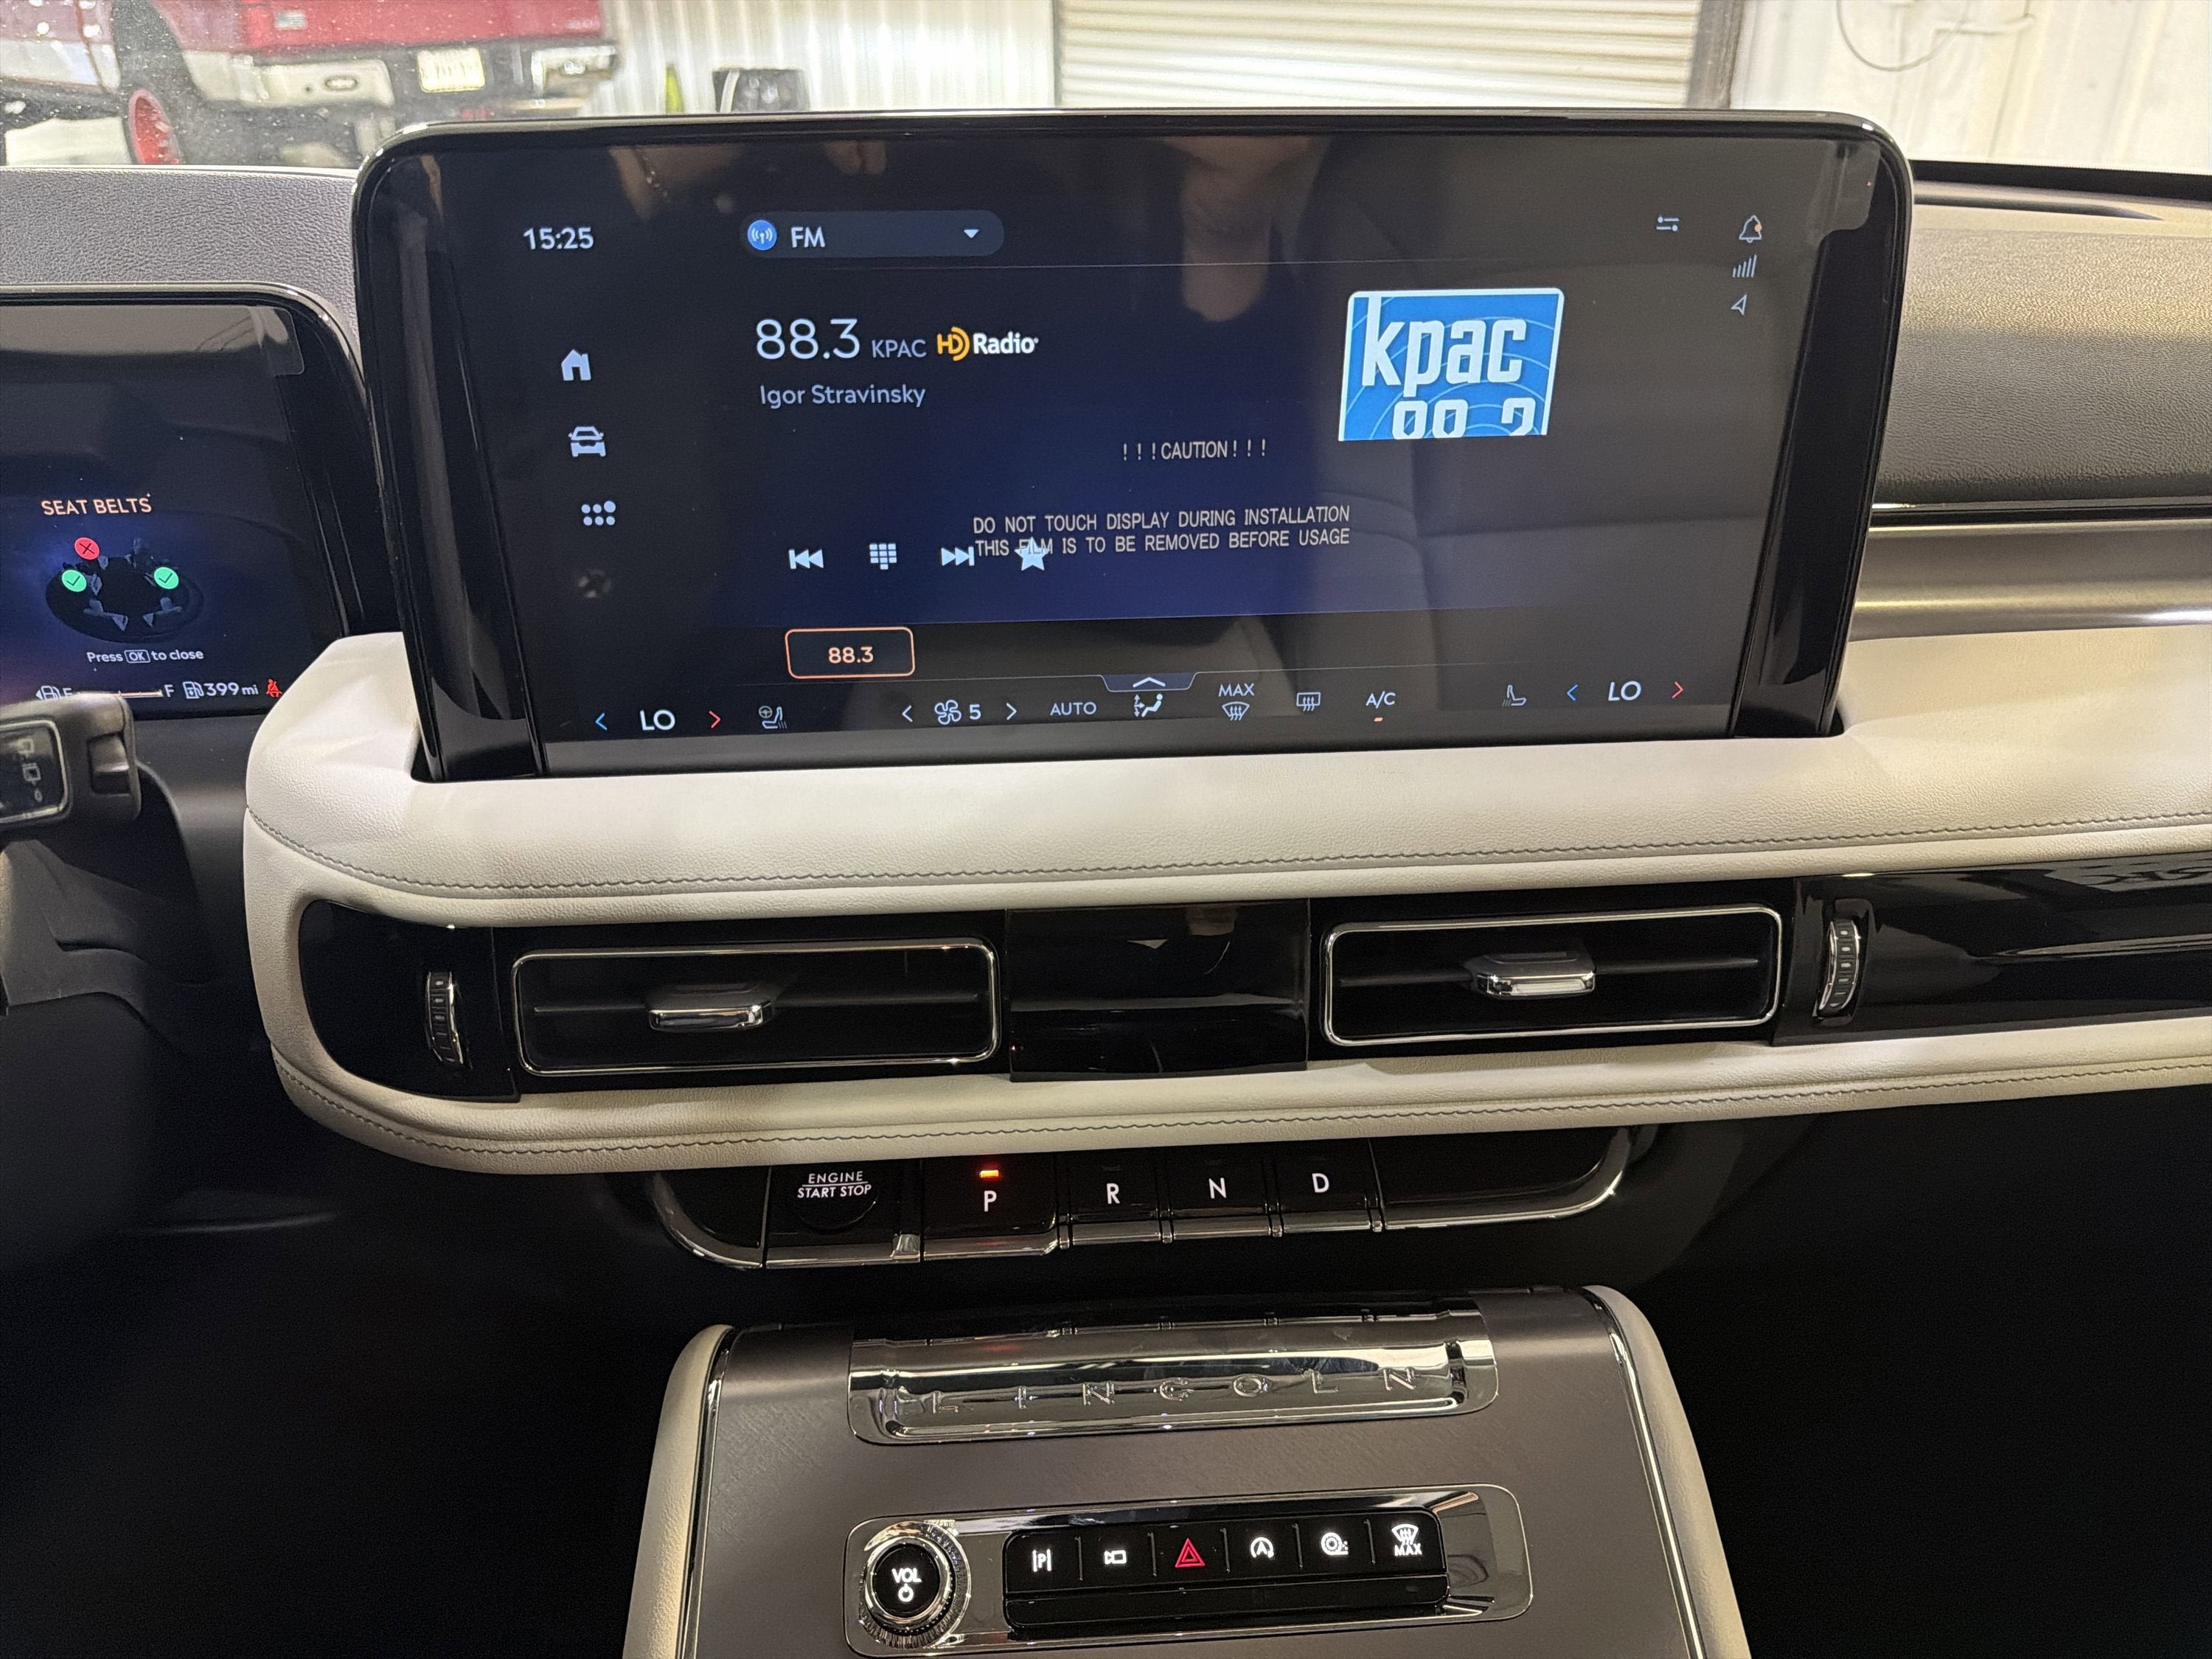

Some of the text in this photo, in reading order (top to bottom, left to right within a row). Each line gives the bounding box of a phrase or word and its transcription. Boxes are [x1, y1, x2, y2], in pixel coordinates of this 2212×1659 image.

[524, 226, 594, 250] 15:25
[790, 226, 826, 248] FM
[756, 318, 860, 360] 88.3
[872, 338, 927, 358] KPAC
[1362, 296, 1527, 397] kpac
[760, 383, 926, 409] Igor Stravinsky
[41, 498, 152, 515] SEAT BELTS
[973, 505, 1350, 534] DO NOT TOUCH DISPLAY DURING INSTALLATION
[975, 539, 1009, 557] THIS
[1062, 537, 1077, 554] IS
[1085, 536, 1106, 554] TO
[1115, 535, 1136, 552] BE
[1145, 532, 1220, 552] REMOVED
[1228, 529, 1290, 549] BEFORE
[1299, 527, 1350, 546] USAGE
[86, 649, 204, 663] Press OK to close
[828, 646, 874, 664] 88.3
[164, 684, 175, 698] F
[203, 682, 259, 697] 399 mi
[1218, 683, 1255, 697] MAX
[1608, 681, 1642, 701] LO
[1050, 701, 1097, 716] AUTO
[1366, 691, 1396, 709] A/C
[639, 709, 675, 731] LO
[969, 703, 981, 720] 5
[808, 1171, 863, 1183] ENGINE
[1312, 1172, 1329, 1193] D
[798, 1184, 872, 1198] START STOP
[1106, 1183, 1121, 1205] R
[1208, 1178, 1227, 1199] N
[984, 1190, 997, 1212] P
[1394, 1543, 1422, 1557] MAX
[891, 1568, 922, 1584] VOL
